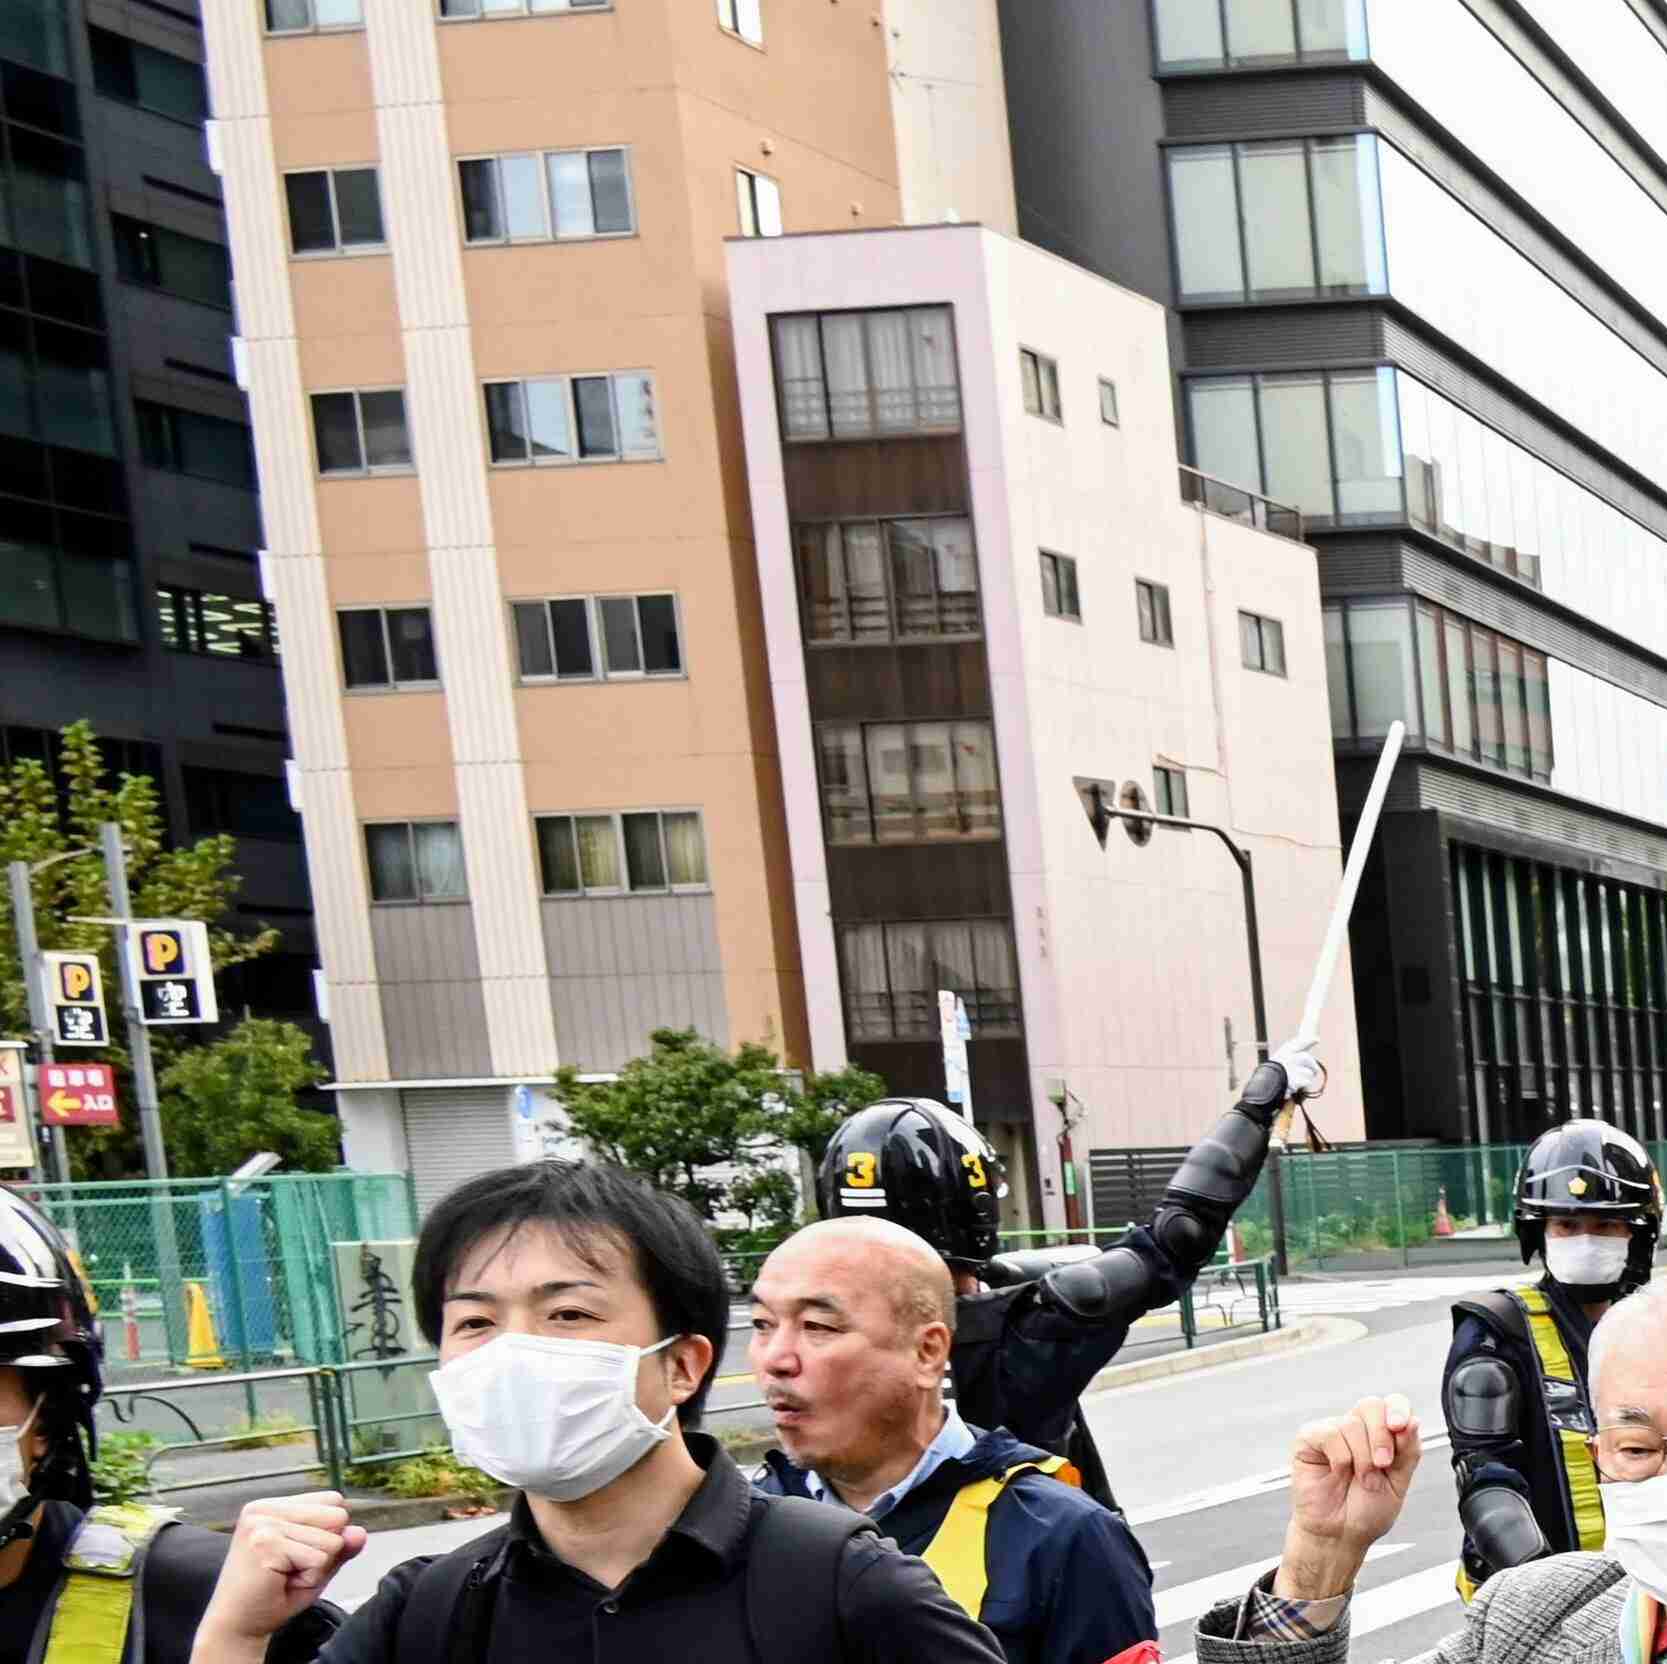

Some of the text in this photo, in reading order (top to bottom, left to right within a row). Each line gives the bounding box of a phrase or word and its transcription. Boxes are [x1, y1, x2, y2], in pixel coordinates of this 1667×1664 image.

[147, 933, 178, 971] P
[64, 963, 91, 1000] P
[845, 1151, 875, 1189] 3
[961, 1153, 986, 1189] 3
